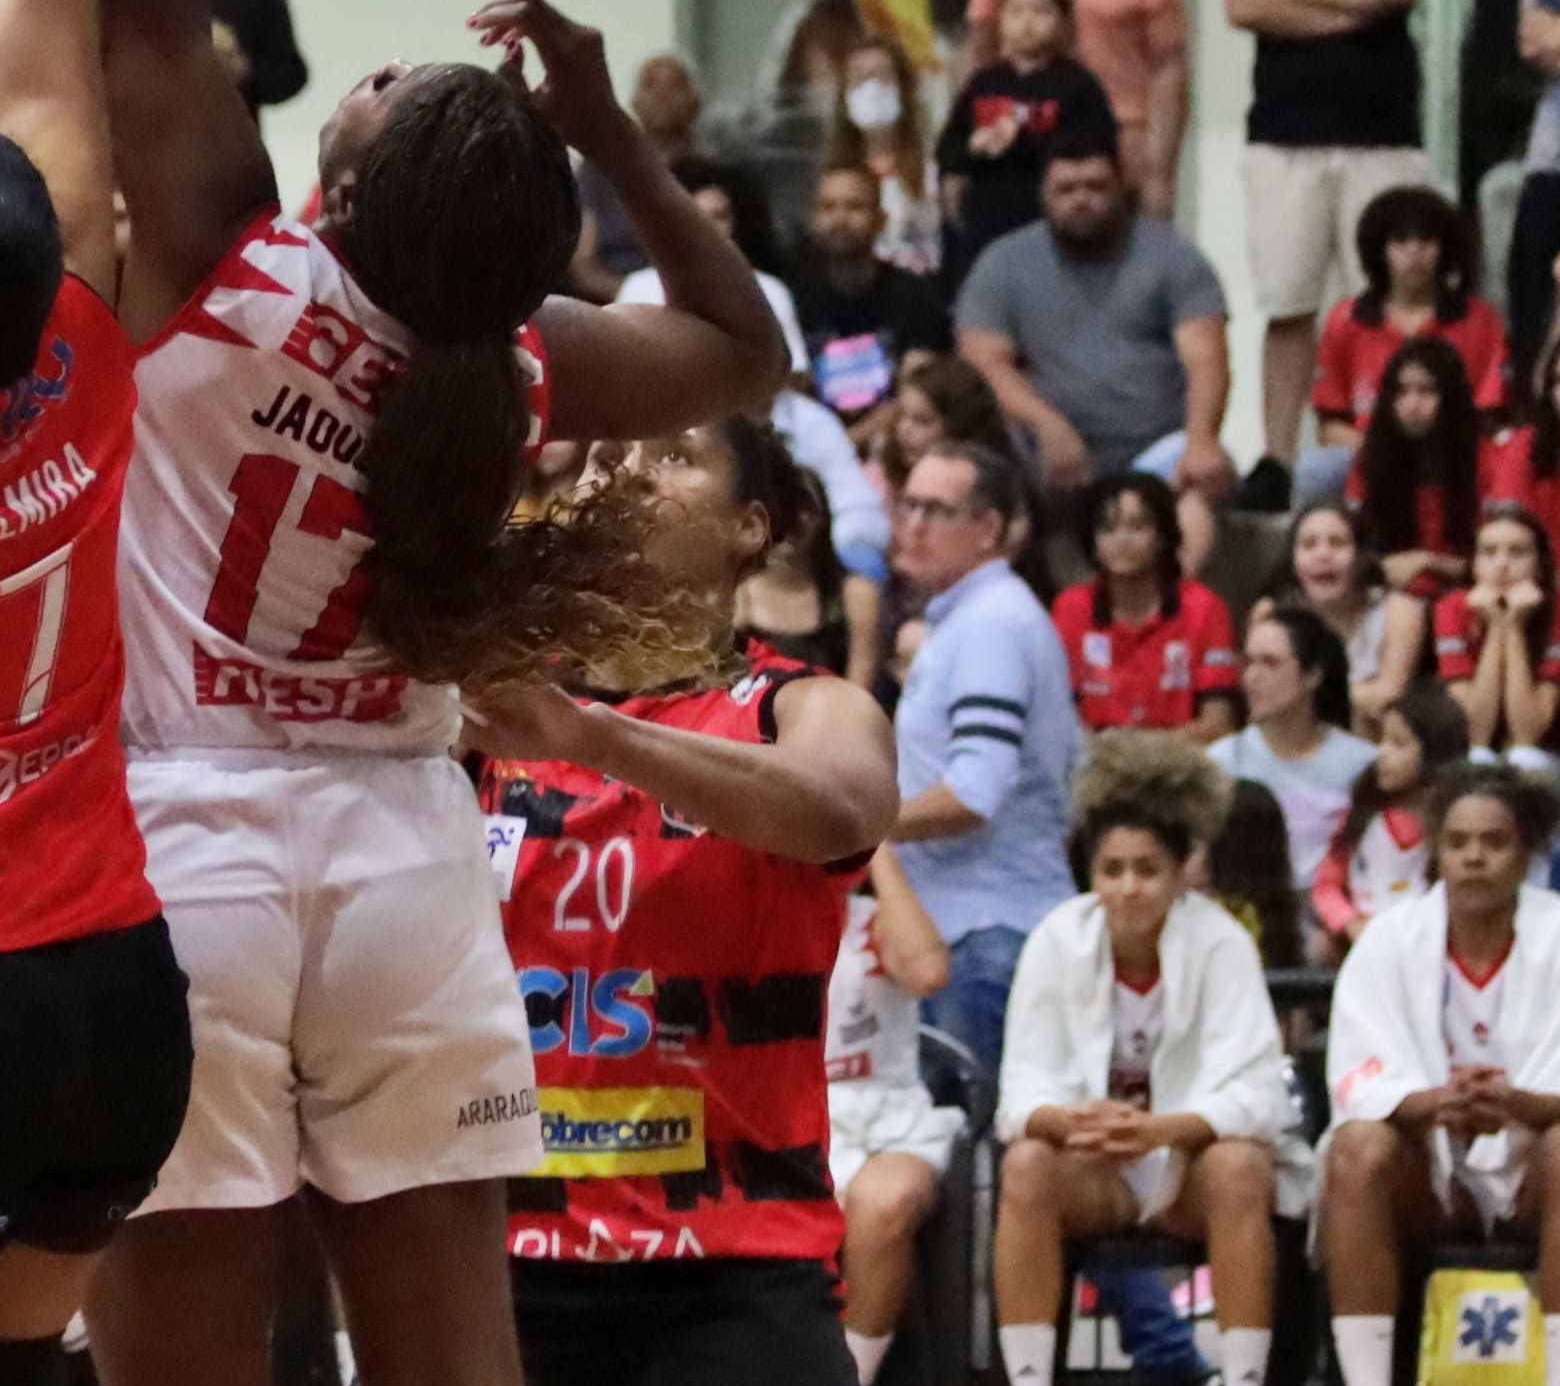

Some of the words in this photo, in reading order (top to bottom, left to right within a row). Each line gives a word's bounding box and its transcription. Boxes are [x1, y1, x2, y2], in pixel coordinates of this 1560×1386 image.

[203, 452, 378, 662] 17
[551, 834, 636, 933] 20
[517, 965, 654, 1059] CIS
